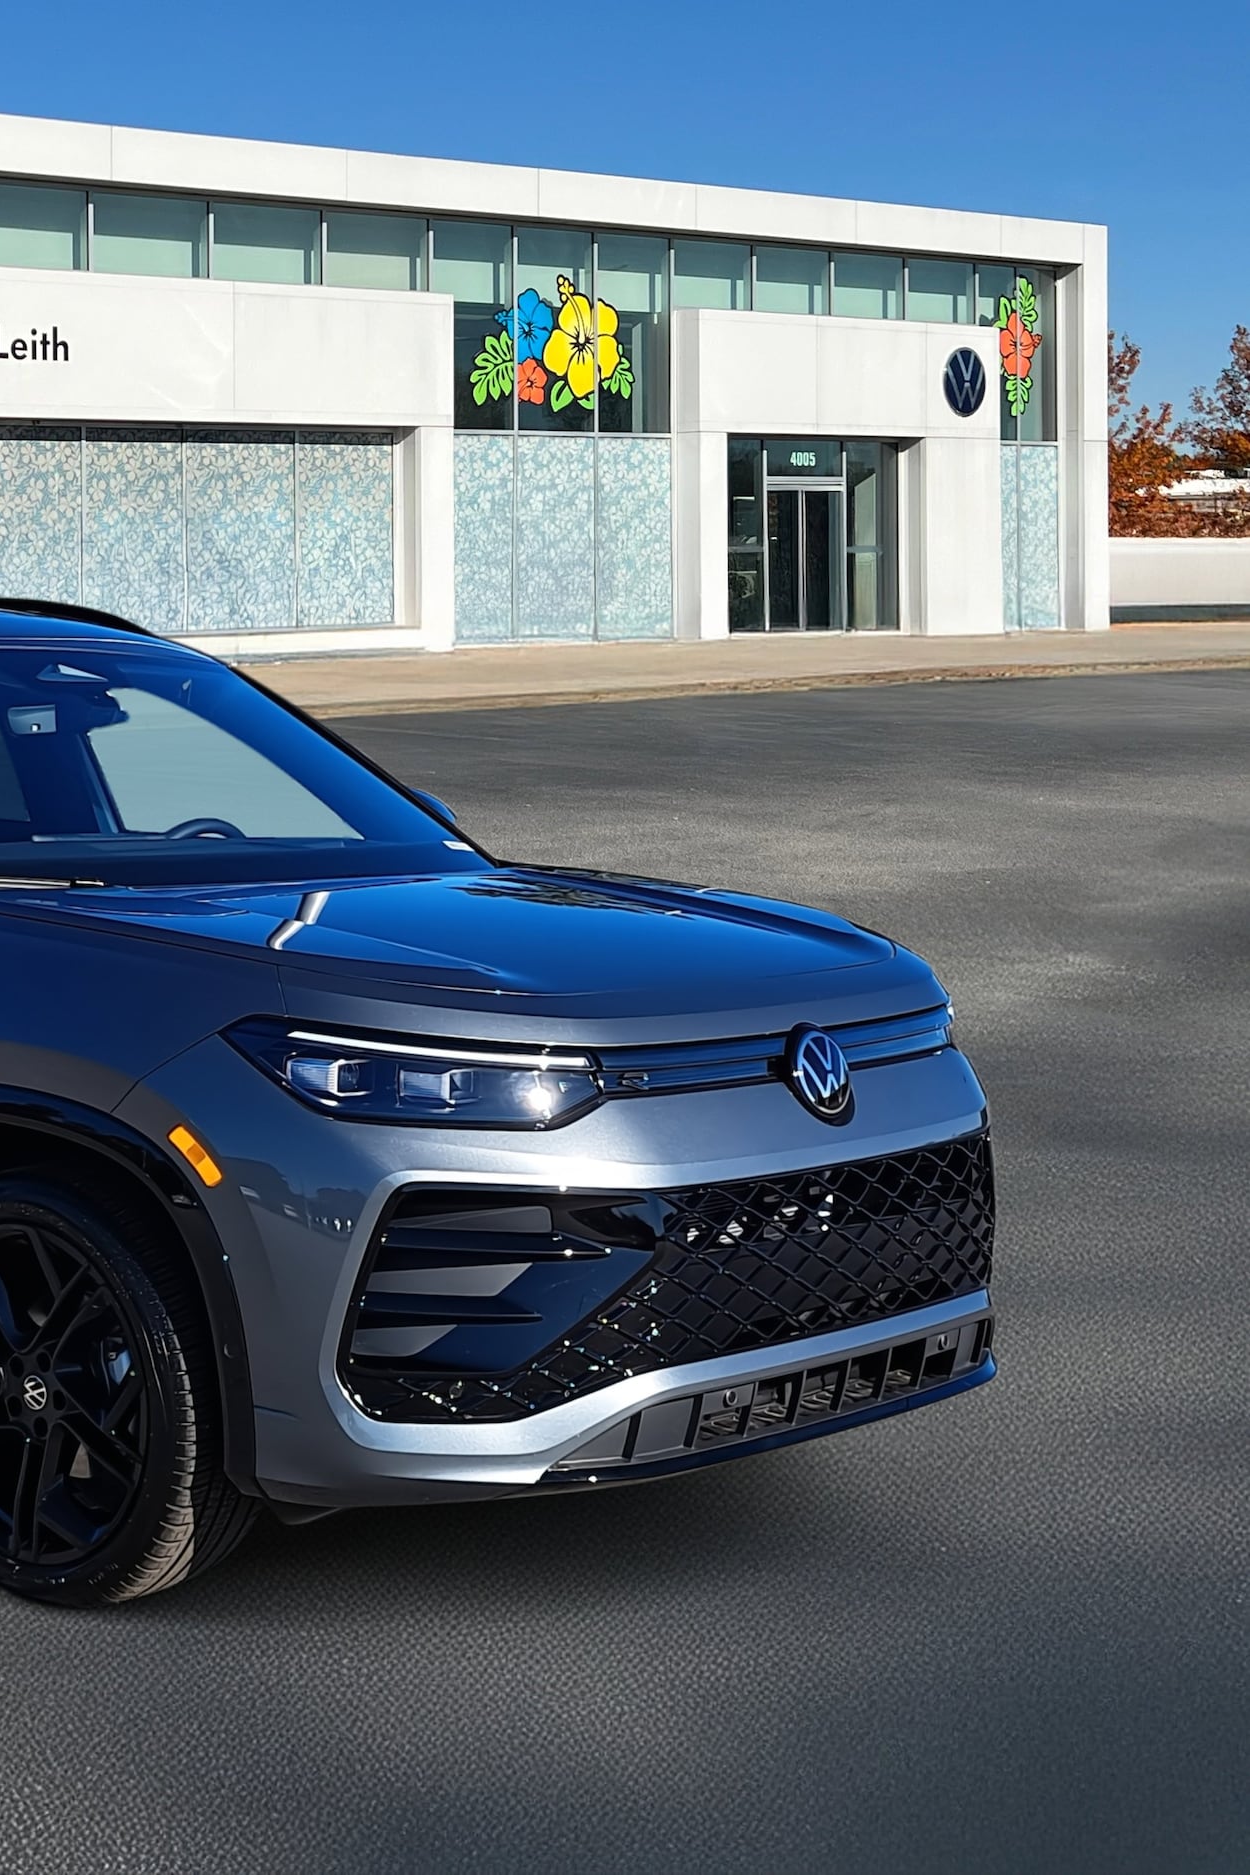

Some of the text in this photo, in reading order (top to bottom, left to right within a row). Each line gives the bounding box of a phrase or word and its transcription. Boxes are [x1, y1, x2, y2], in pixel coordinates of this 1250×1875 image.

[945, 348, 986, 413] VW
[790, 452, 816, 467] 4005
[798, 1033, 848, 1107] VW
